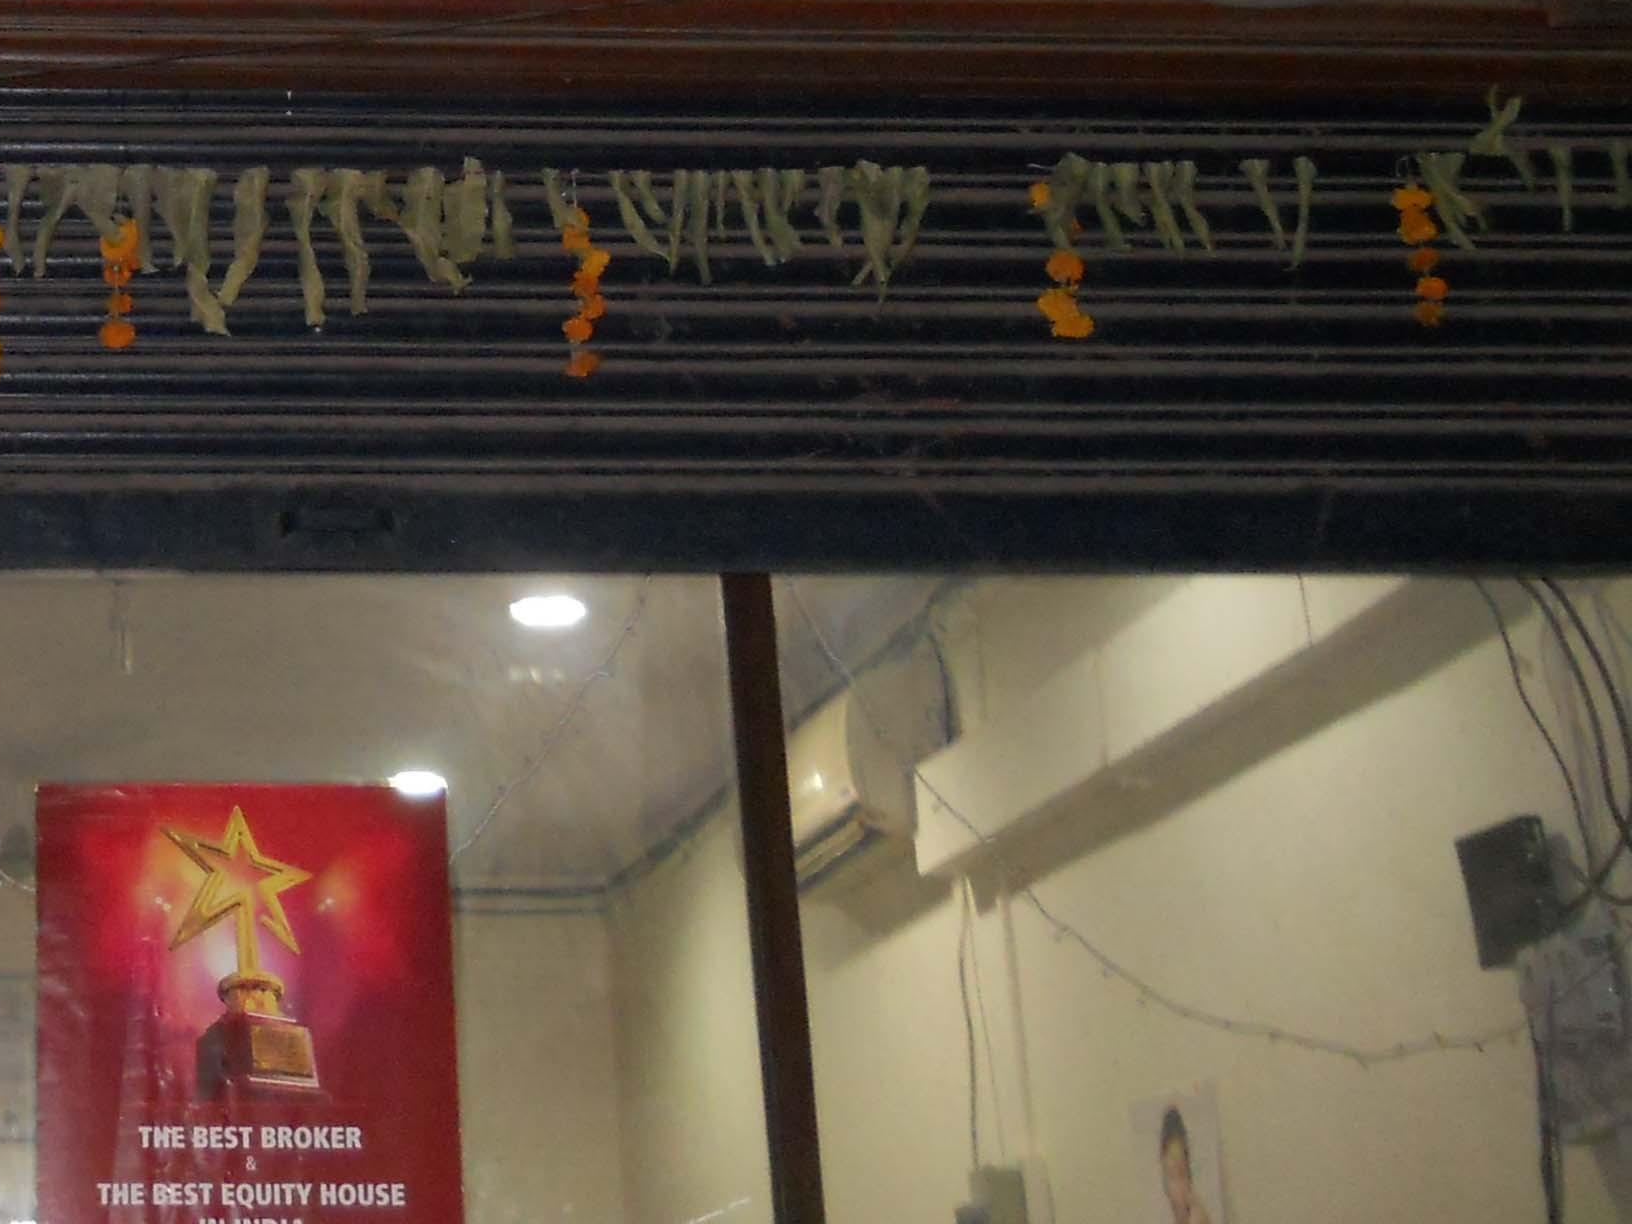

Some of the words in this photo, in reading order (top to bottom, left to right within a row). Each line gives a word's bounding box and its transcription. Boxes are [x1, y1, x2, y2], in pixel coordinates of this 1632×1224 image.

[139, 1126, 185, 1149] THE
[192, 1126, 253, 1149] BEST
[261, 1126, 362, 1149] BROKER
[245, 1155, 257, 1171] &
[97, 1183, 145, 1206] THE
[152, 1183, 214, 1206] BEST
[221, 1183, 313, 1209] EQUITY
[319, 1183, 406, 1206] HOUSE
